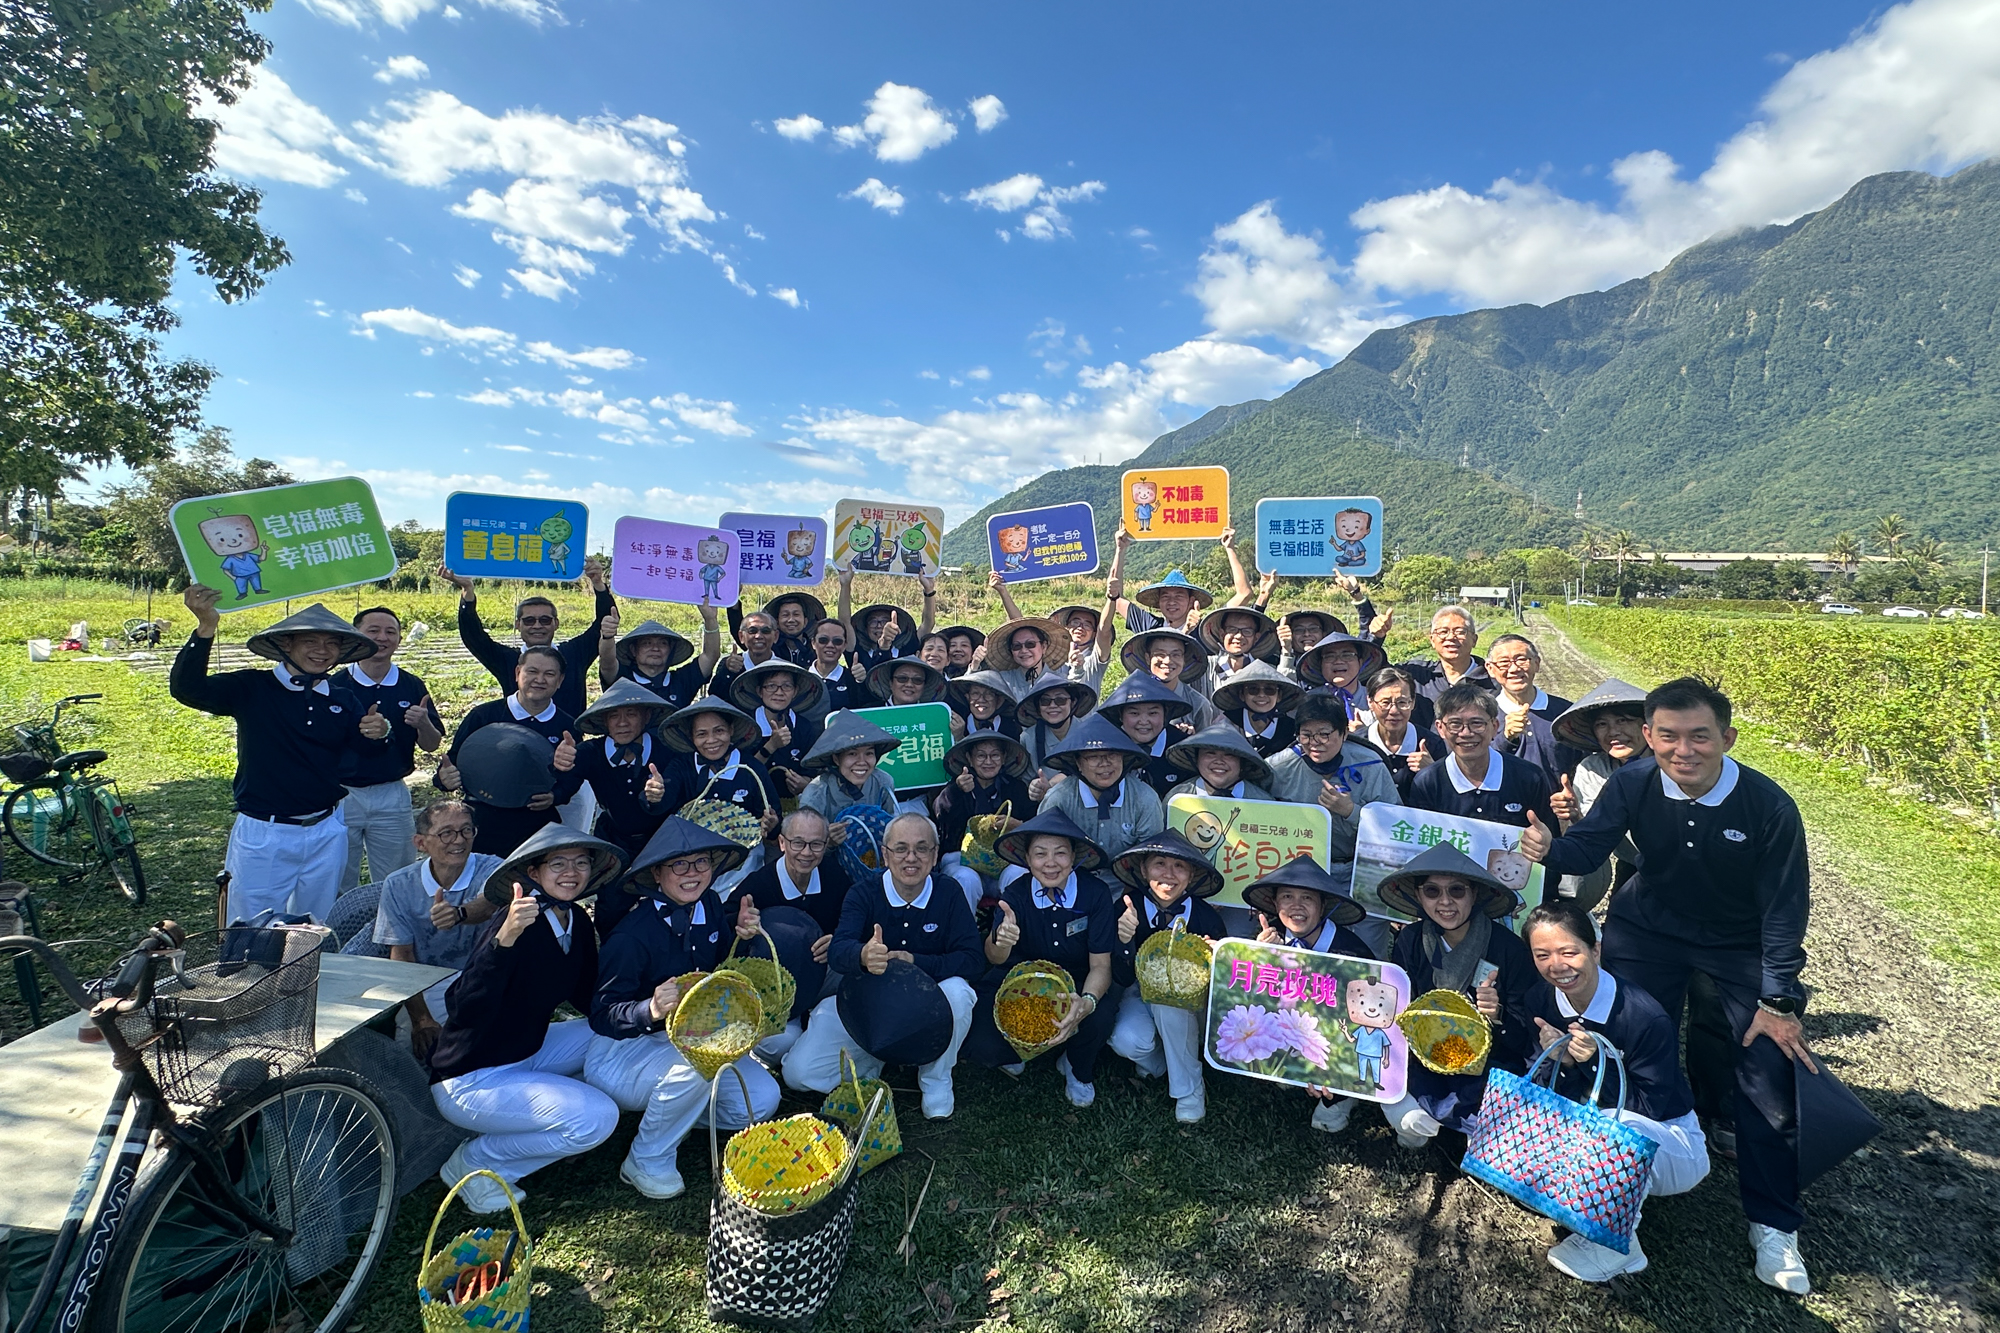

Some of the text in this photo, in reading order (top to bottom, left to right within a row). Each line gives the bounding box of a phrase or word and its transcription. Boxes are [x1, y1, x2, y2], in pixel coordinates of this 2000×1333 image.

[1162, 485, 1203, 502] 不加毒
[262, 502, 365, 539] 皂福無毒
[861, 507, 919, 522] 皂福三兄弟
[1162, 507, 1218, 524] 只加幸福
[462, 518, 528, 531] 皂福三兄弟 二哥
[1030, 523, 1047, 535] 考試
[1269, 518, 1324, 535] 無毒生活
[737, 529, 775, 548] 皂福
[1031, 530, 1081, 545] 不一定一百分
[275, 533, 376, 570] 幸福加倍
[462, 529, 543, 564] 薈皂福
[630, 541, 694, 562] 純淨無毒
[1033, 541, 1083, 557] 但我們的皂福
[1269, 541, 1324, 557] 皂福相隨
[1034, 551, 1088, 567] 一定天然100分
[630, 564, 694, 582] 一起皂福
[911, 723, 926, 732] 大哥
[1239, 823, 1314, 839] 皂福三兄弟 小弟
[1390, 820, 1472, 854] 金銀花
[1228, 958, 1338, 1008] 月亮玫瑰
[60, 1165, 135, 1333] CROWN
